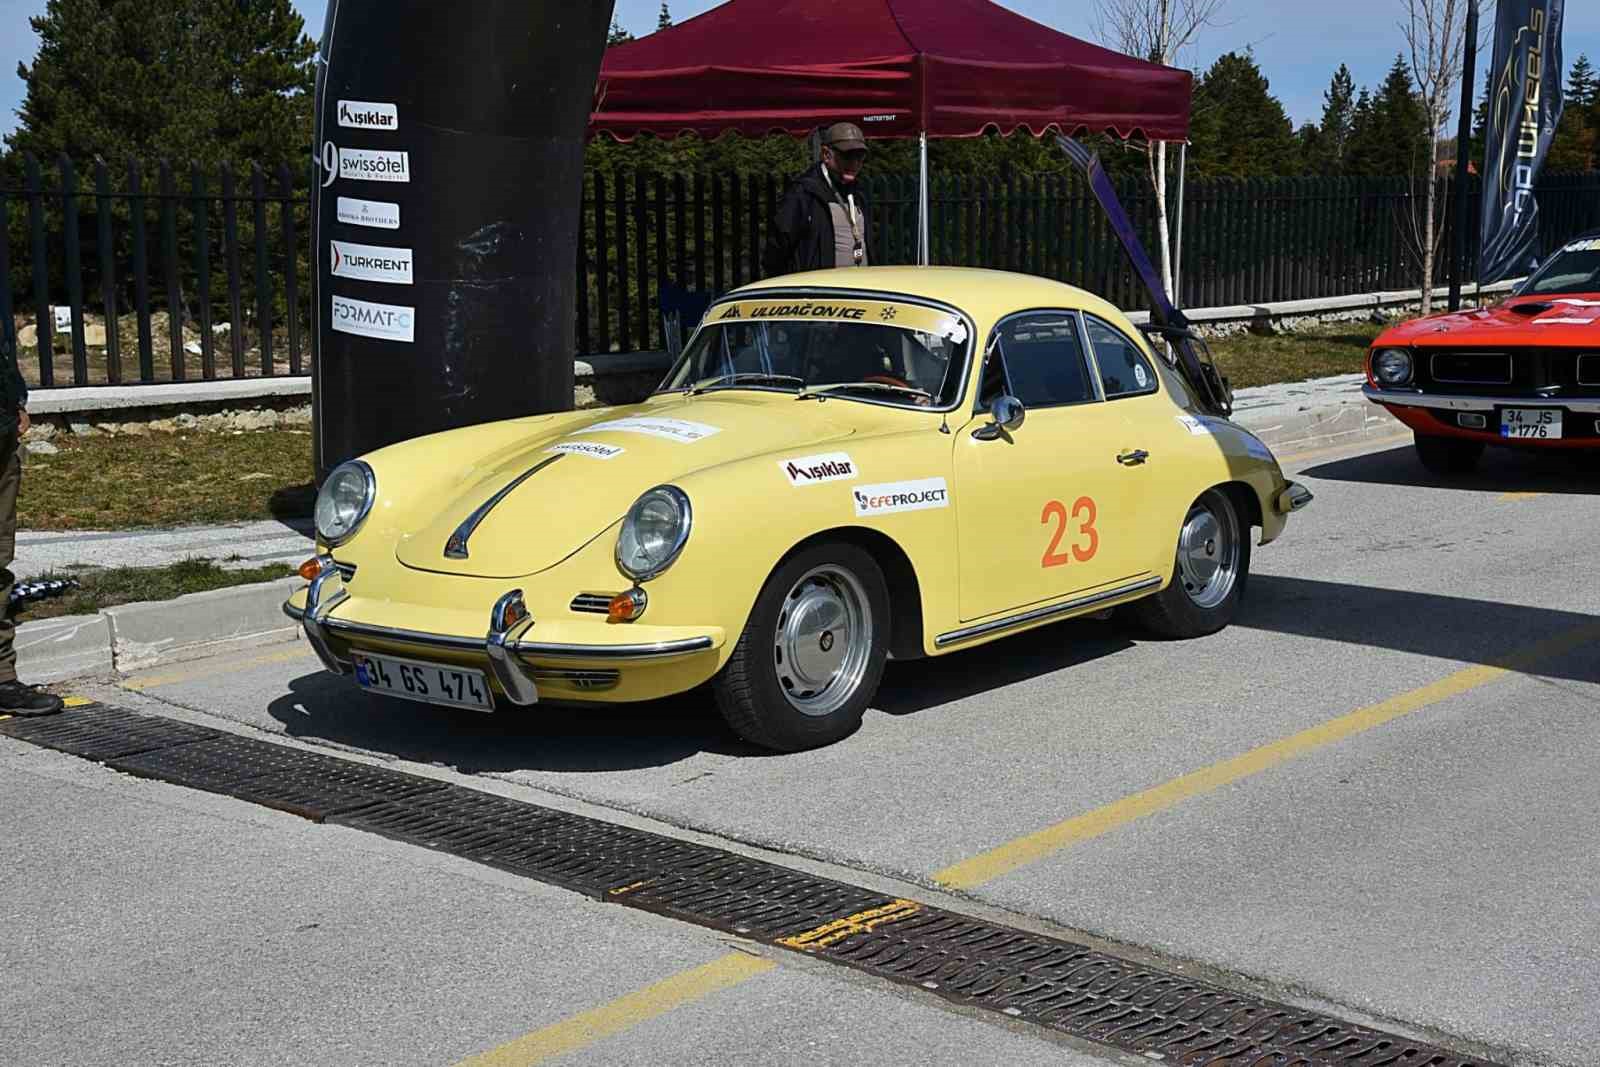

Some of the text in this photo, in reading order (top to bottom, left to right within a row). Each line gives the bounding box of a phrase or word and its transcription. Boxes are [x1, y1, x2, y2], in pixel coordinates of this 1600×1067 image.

[354, 111, 394, 126] ışıklar
[321, 141, 339, 188] 9
[342, 153, 405, 173] swissôtel
[343, 254, 410, 271] TURKRENT
[751, 303, 812, 318] ULUDAĞ
[837, 306, 867, 319] ICE
[1507, 410, 1553, 424] 34 JS
[1518, 425, 1548, 438] 1776
[808, 461, 853, 480] ışıklar
[869, 489, 946, 508] EFEPROJECT
[1041, 496, 1098, 568] 23
[366, 658, 483, 703] 34 GS 474
